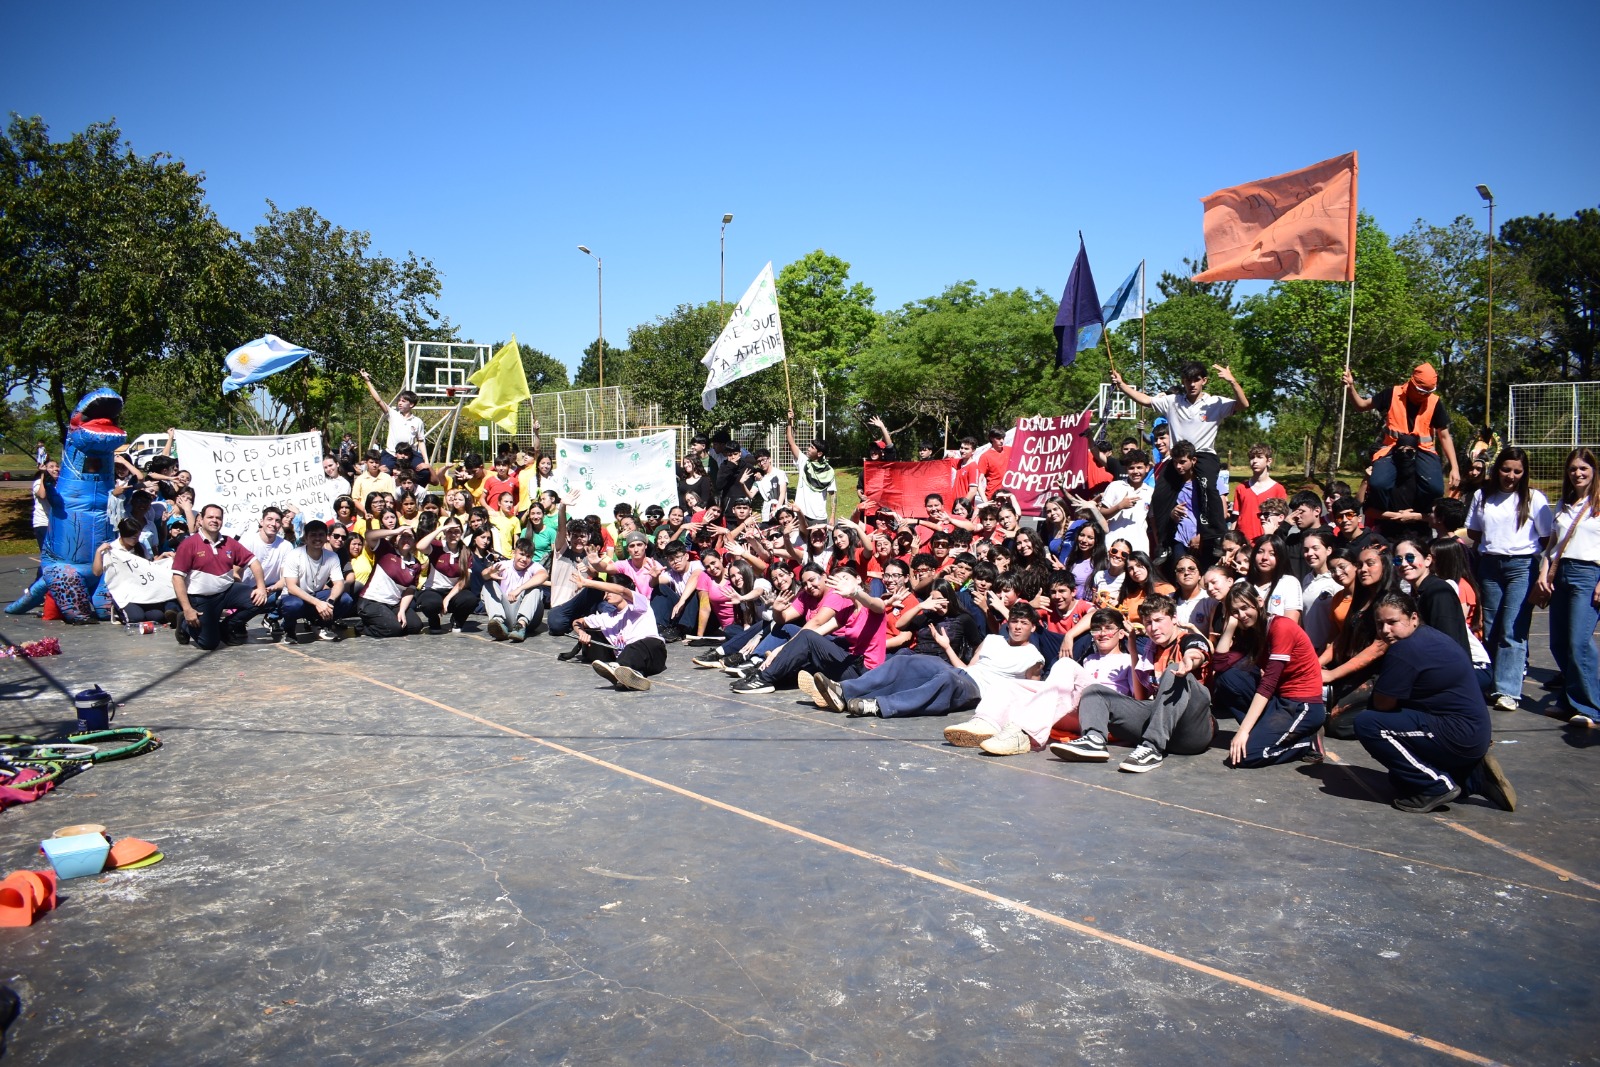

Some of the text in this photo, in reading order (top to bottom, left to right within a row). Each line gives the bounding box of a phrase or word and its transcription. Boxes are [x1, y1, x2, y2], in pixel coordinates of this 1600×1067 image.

[1019, 412, 1082, 432] DONDE HAY
[212, 436, 318, 463] NO ES SUERTE
[1023, 432, 1073, 455] CALIDAD
[1018, 451, 1070, 472] NO HAY
[139, 571, 155, 586] 38
